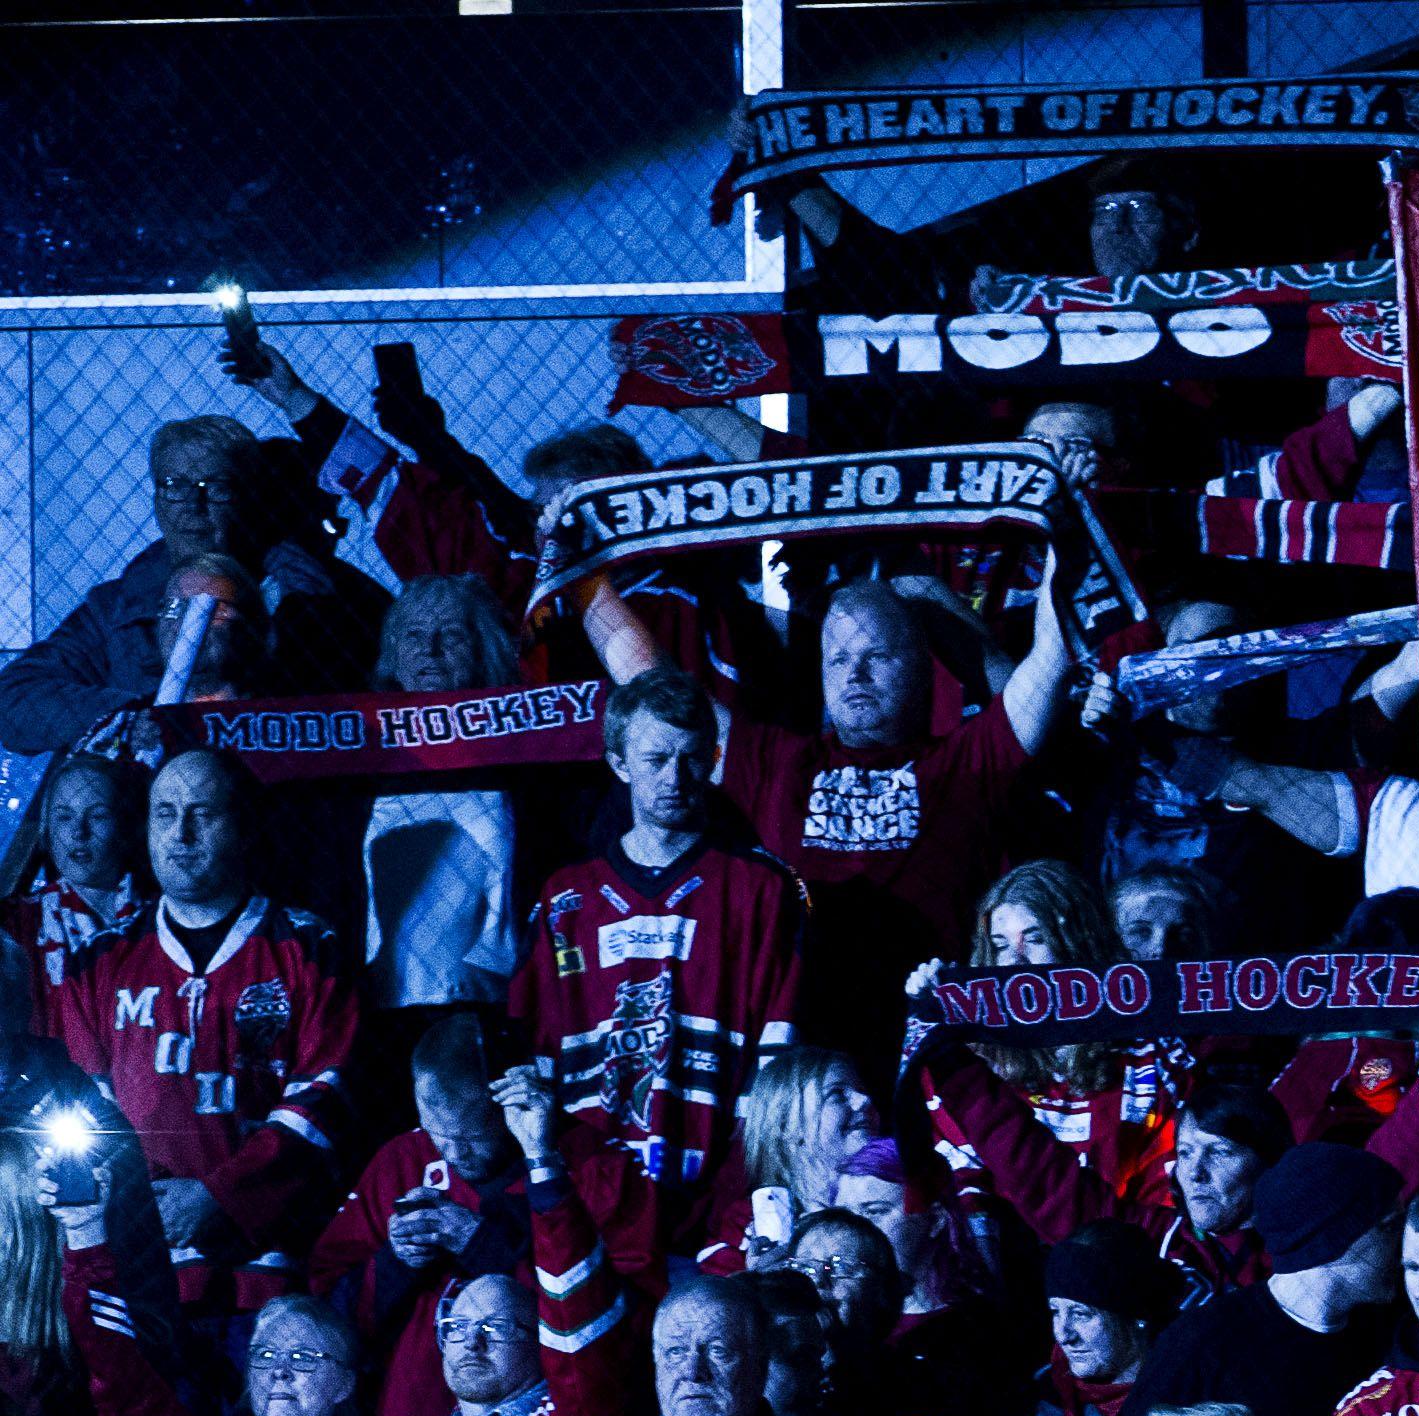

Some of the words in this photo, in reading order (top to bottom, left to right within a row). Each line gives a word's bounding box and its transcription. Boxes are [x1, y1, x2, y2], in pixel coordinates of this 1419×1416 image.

[826, 96, 1023, 147] HEART
[1041, 93, 1123, 132] OF
[1127, 83, 1390, 130] HOCKEY.
[817, 305, 1273, 376] MODO
[825, 464, 901, 510] OF
[205, 711, 363, 752] MODO
[380, 680, 599, 748] HOCKEY
[933, 964, 1151, 1027] MODO
